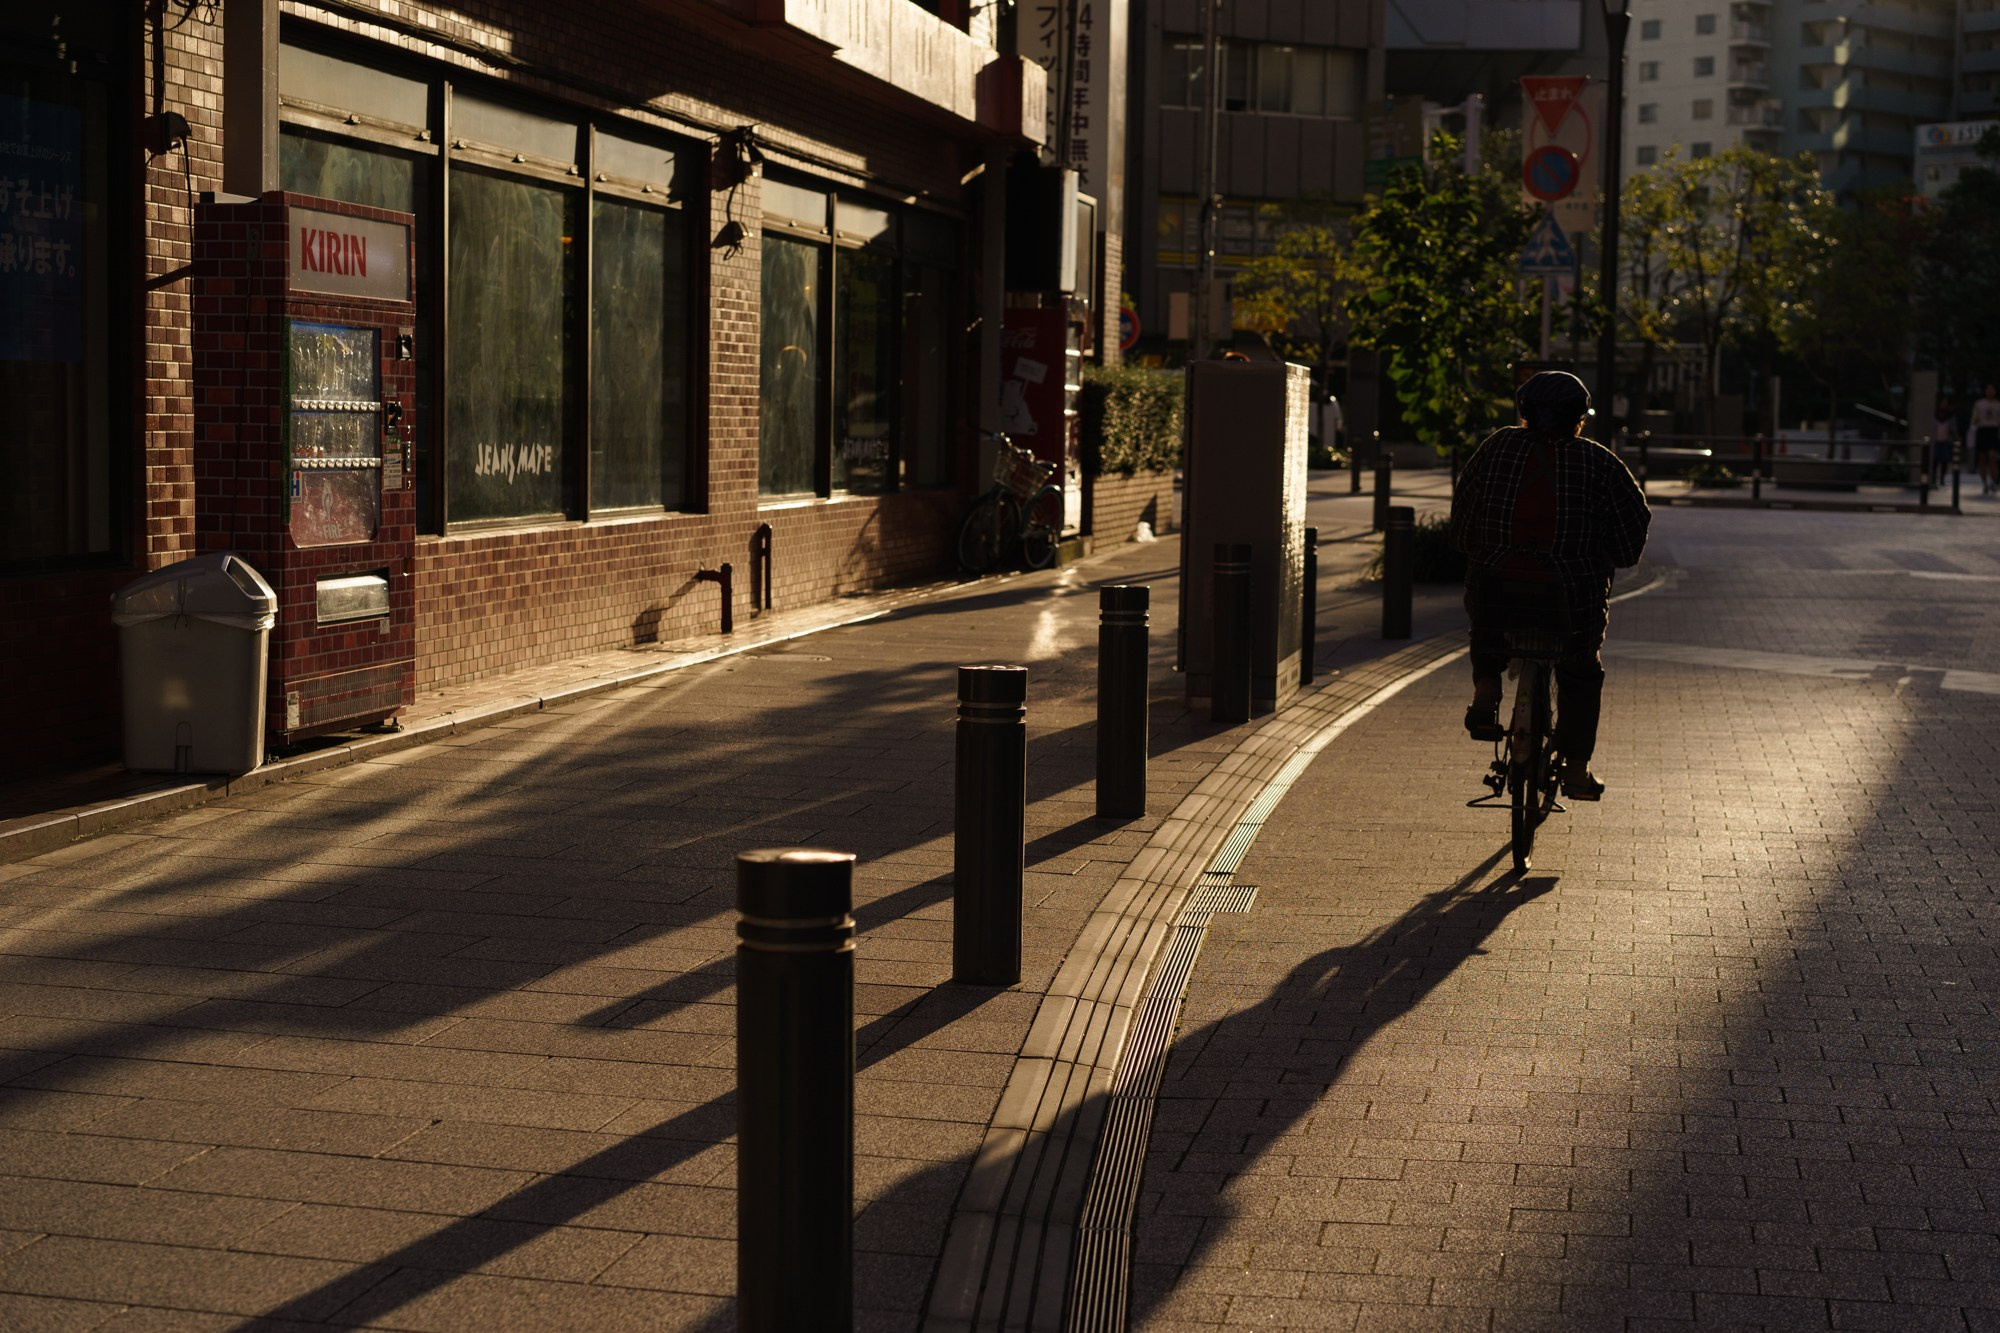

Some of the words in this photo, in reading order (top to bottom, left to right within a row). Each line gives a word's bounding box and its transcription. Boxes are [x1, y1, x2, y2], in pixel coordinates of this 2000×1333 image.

[1535, 87, 1574, 101] 止まれ
[301, 227, 367, 278] KIRIN
[475, 442, 515, 485] JEANS
[516, 442, 552, 475] MATE
[322, 523, 343, 539] FIRE
